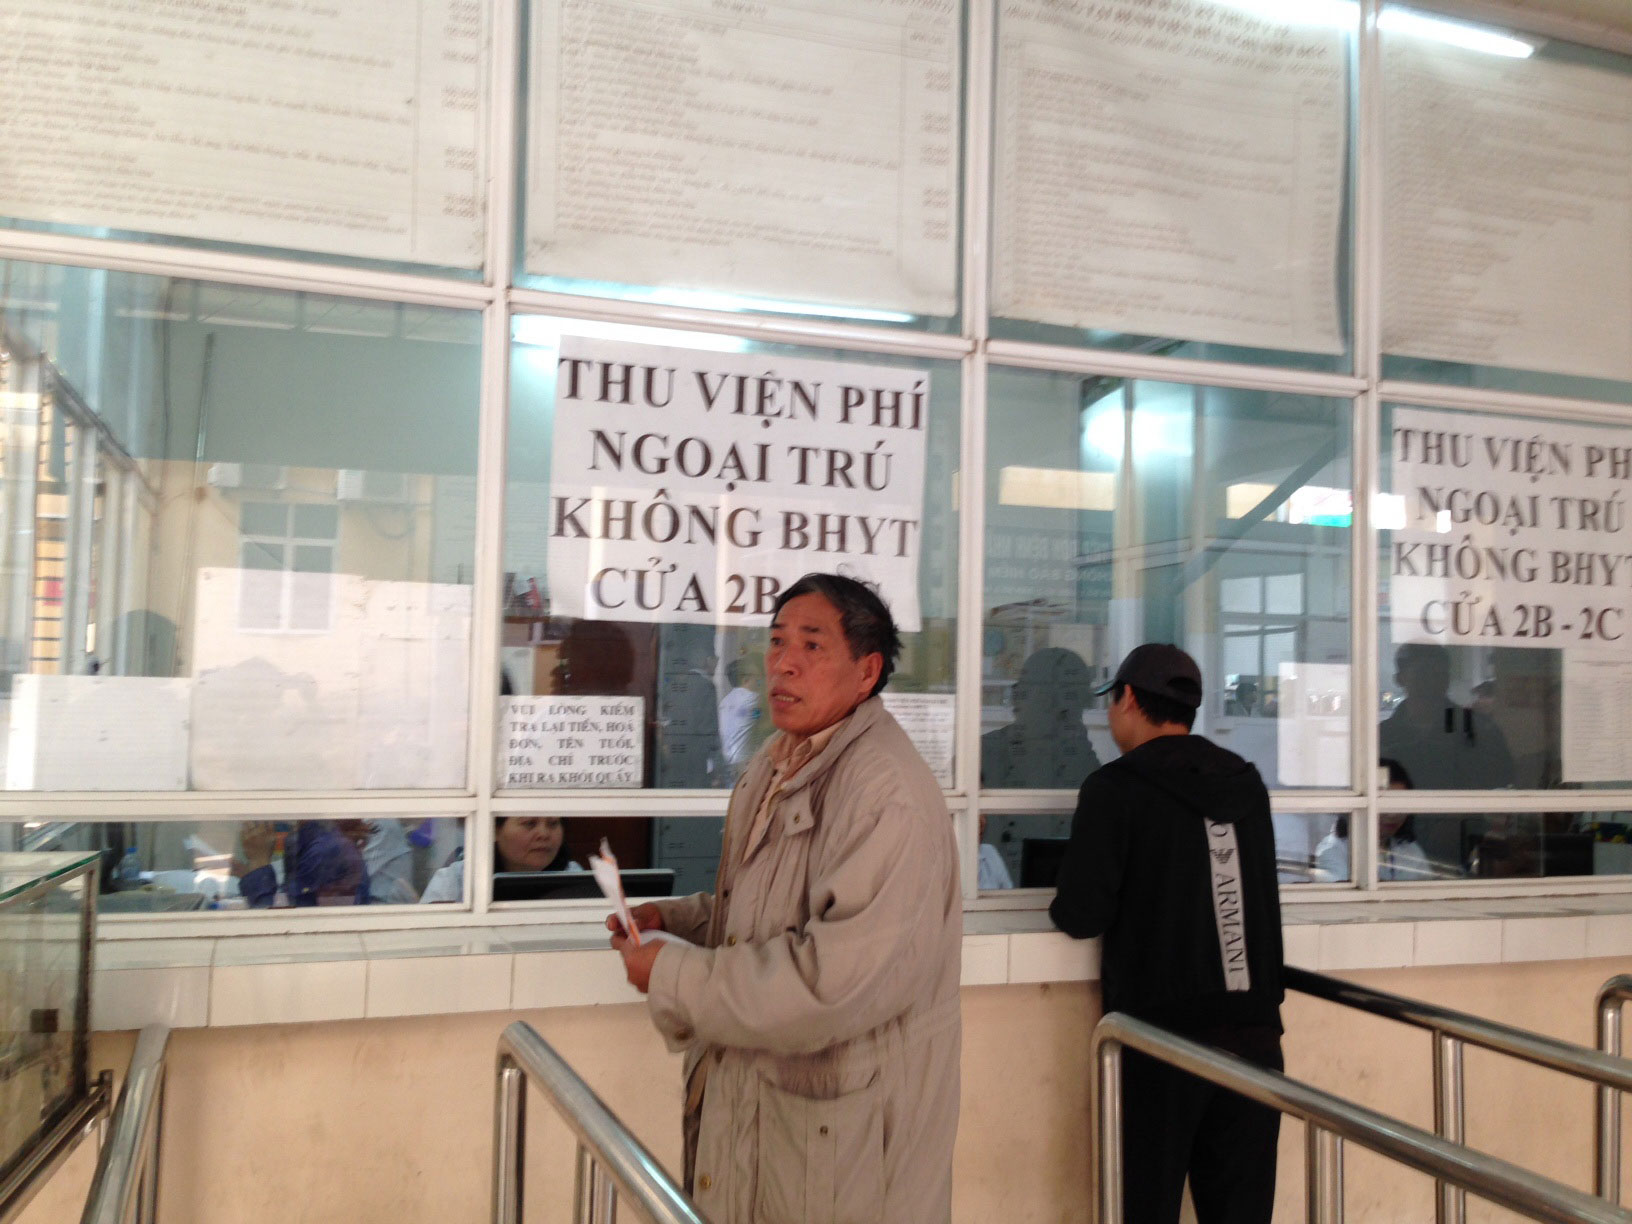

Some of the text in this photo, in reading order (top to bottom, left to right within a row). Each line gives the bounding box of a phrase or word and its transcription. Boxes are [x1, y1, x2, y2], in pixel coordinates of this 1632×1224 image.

[558, 358, 926, 431] THU VIỆN PHÍ
[588, 430, 893, 492] NGOẠI TRÚ
[1393, 428, 1632, 484] THU VIỆN PH
[550, 488, 919, 557] KHÔNG BHYT
[1416, 486, 1625, 536] NGOẠI TRÚ
[592, 557, 781, 615] CỬA 2B
[1392, 534, 1538, 583] KHÔNG
[1420, 590, 1504, 636] CỬA
[1216, 873, 1245, 973] ARMANI
